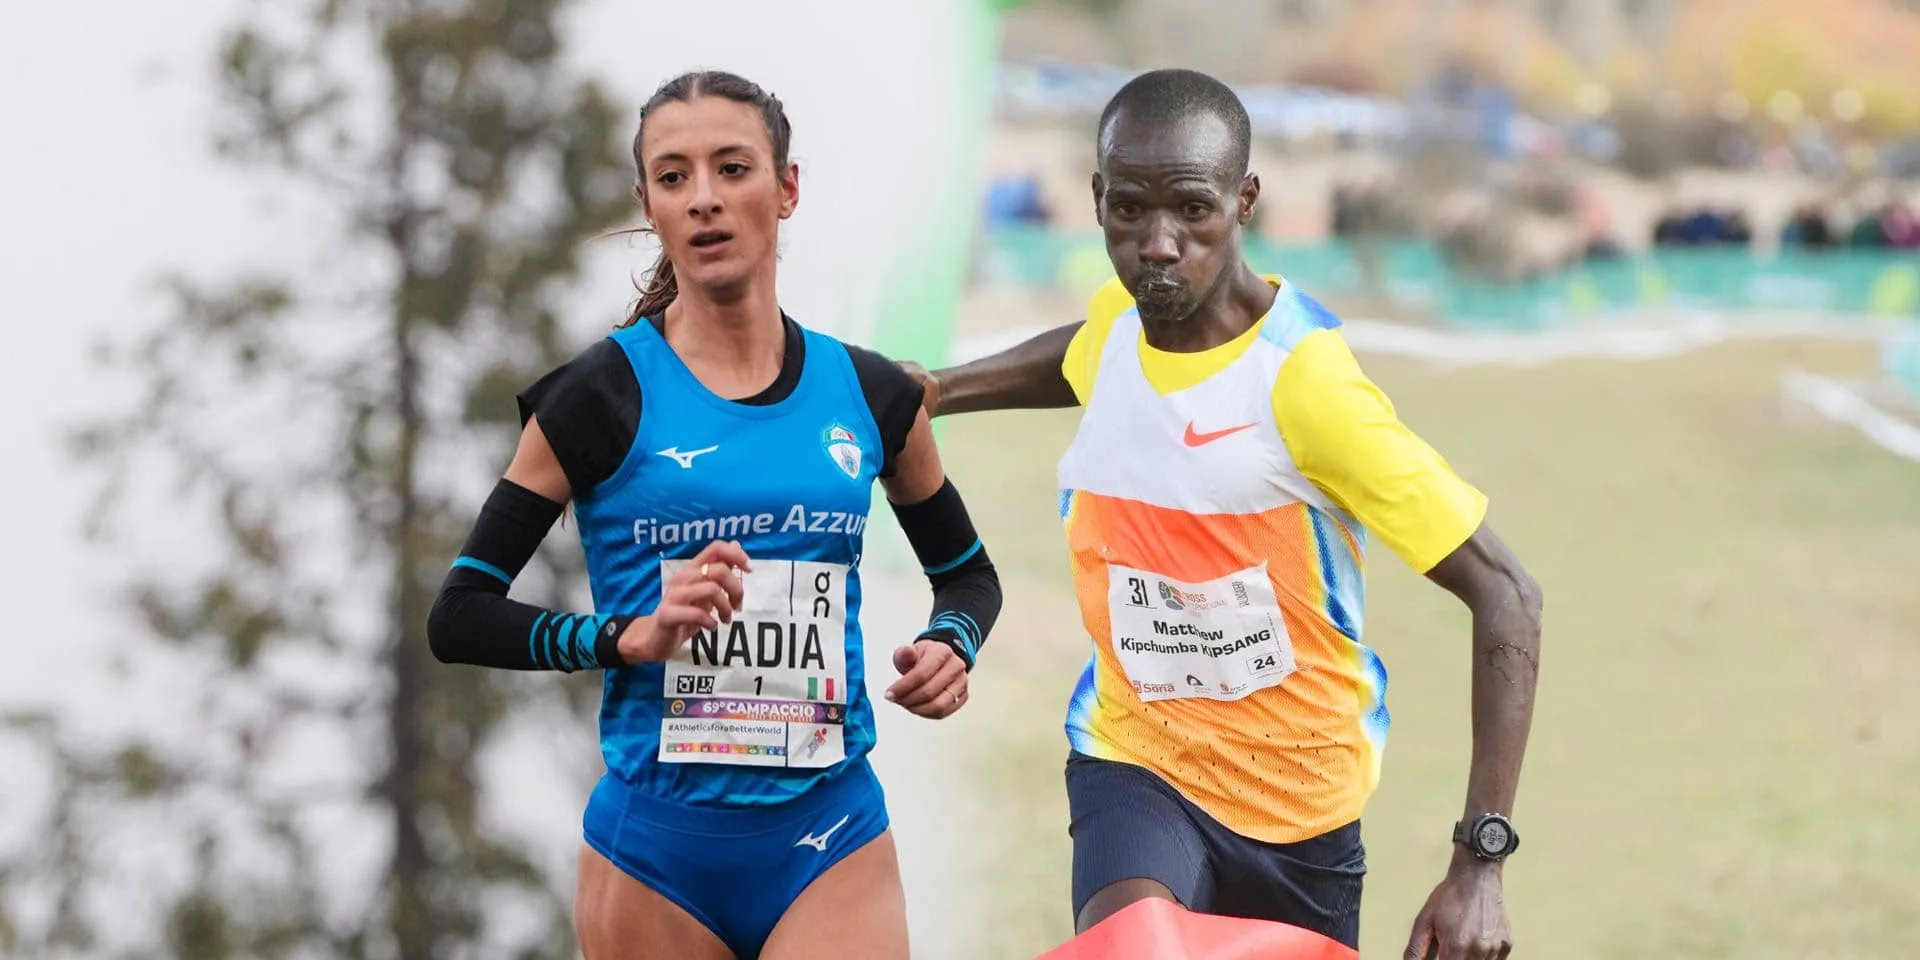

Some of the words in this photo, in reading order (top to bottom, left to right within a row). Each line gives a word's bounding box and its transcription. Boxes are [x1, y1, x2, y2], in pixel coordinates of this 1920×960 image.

[634, 512, 774, 545] Fiamme
[1128, 577, 1149, 606] 31
[1153, 620, 1223, 641] Matthew
[691, 620, 825, 670] NADIA
[1121, 637, 1198, 655] Kipchumba
[1254, 655, 1276, 671] 24
[753, 675, 763, 696] 1
[1143, 682, 1175, 693] Soria
[727, 702, 815, 717] CAMPACCIO
[668, 723, 782, 735] #AthleticsforaBetterWorld
